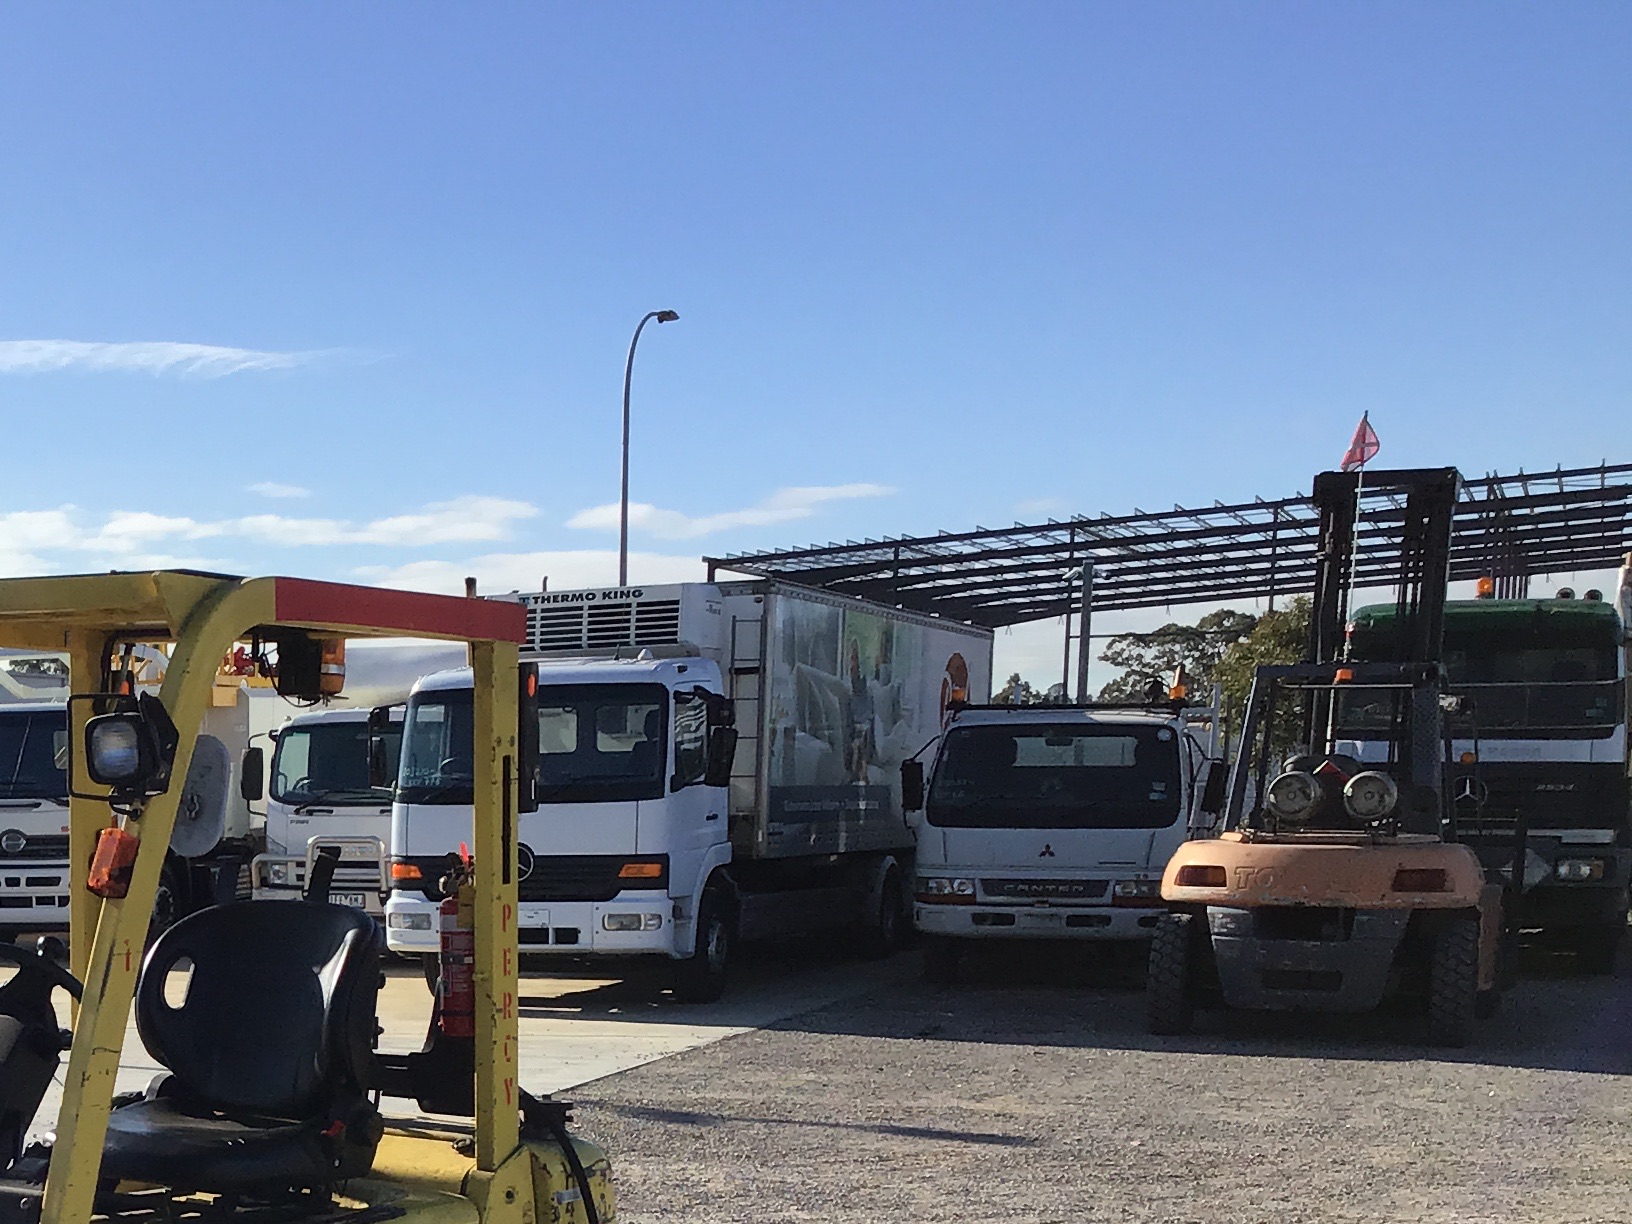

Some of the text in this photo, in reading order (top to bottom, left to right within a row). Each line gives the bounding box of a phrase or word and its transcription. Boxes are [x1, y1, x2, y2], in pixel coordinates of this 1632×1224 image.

[532, 589, 644, 605] THERMO KING
[1004, 884, 1084, 892] CANTER
